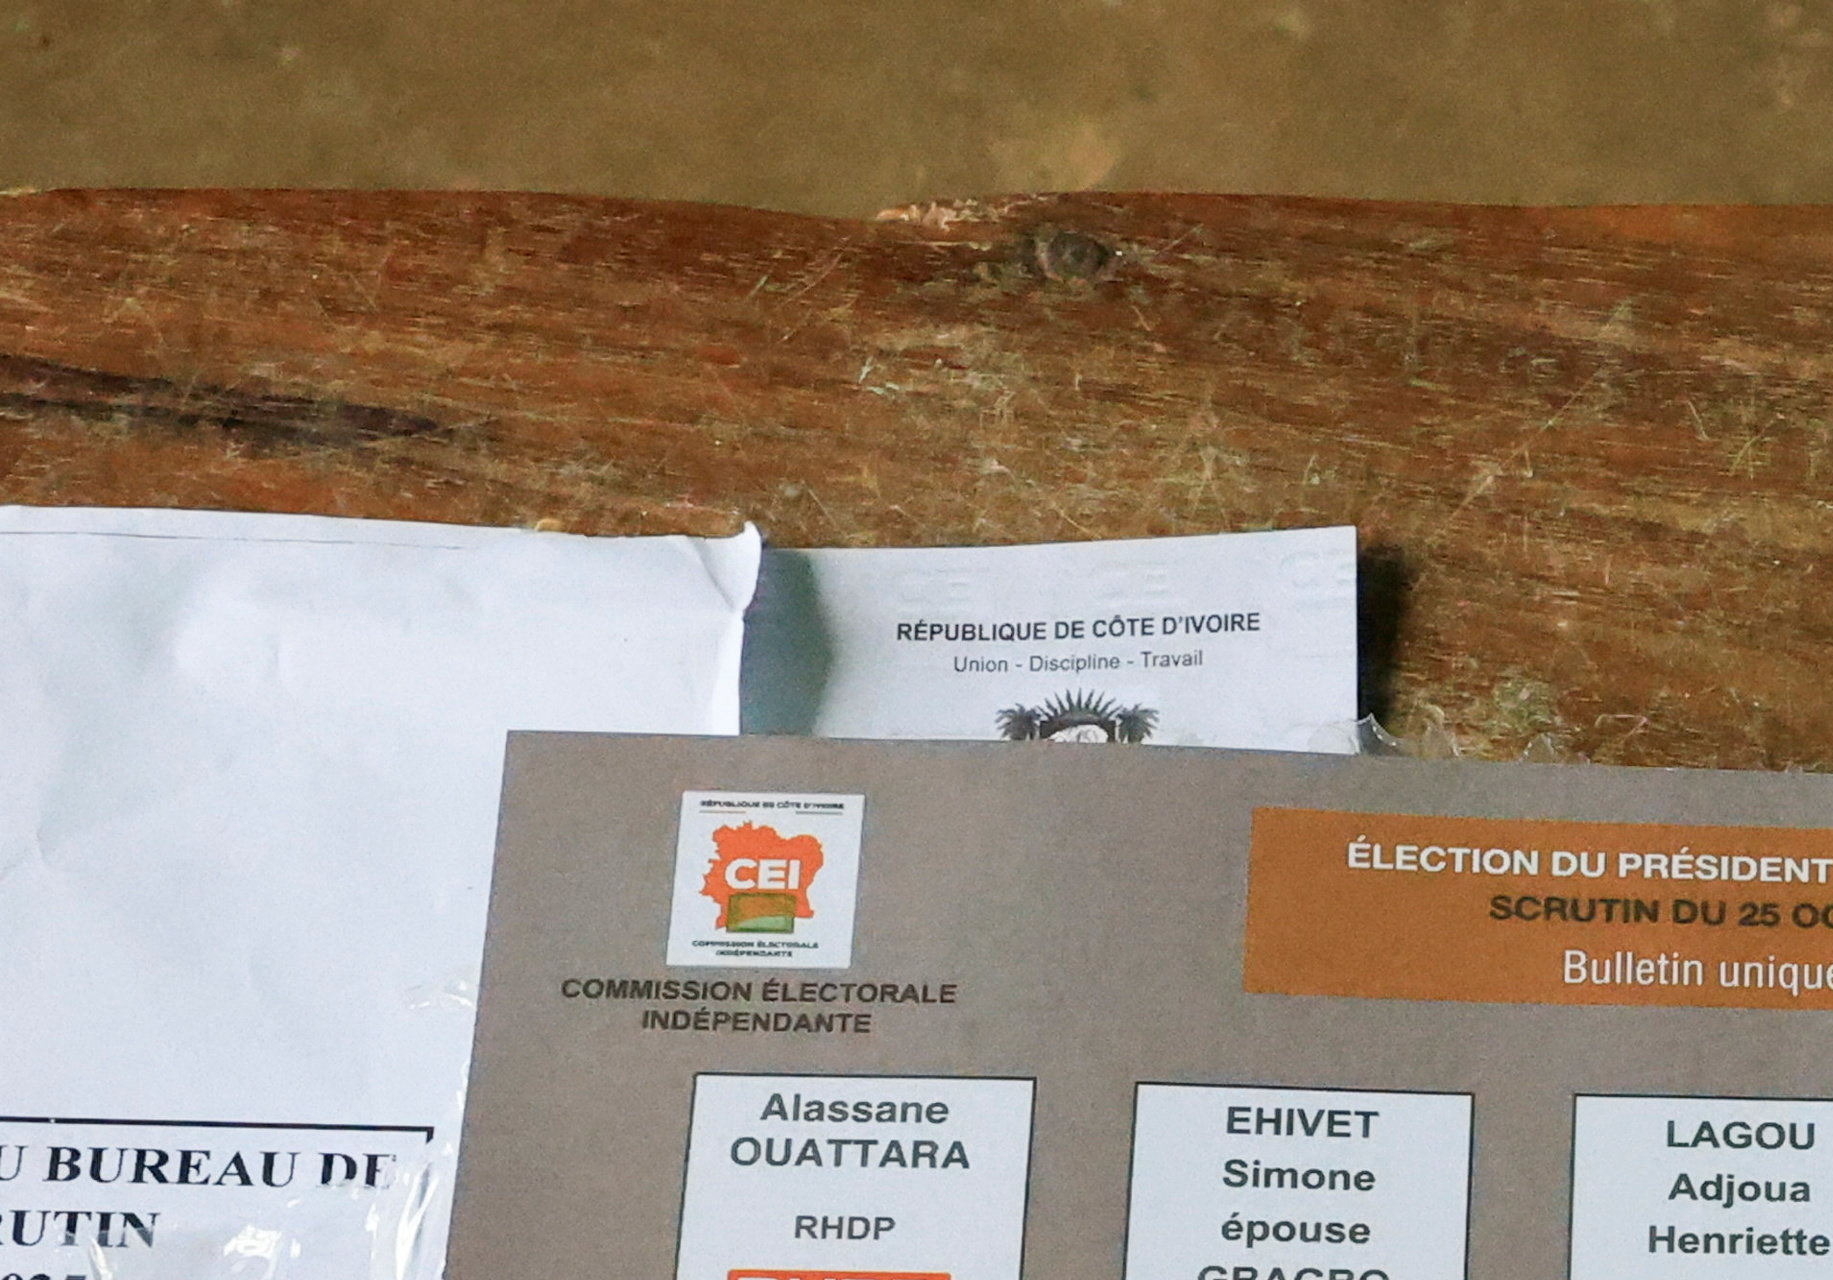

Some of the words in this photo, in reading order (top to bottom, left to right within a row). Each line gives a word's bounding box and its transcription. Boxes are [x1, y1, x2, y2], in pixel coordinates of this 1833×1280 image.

[897, 620, 1047, 643] RÉPUBLIQUE
[1054, 621, 1085, 640] DE
[1092, 614, 1154, 639] CÔTE
[1162, 612, 1260, 635] D'IVOIRE
[954, 655, 1008, 674] Union
[1029, 653, 1120, 675] Discipline
[1141, 649, 1203, 669] Travail
[724, 857, 801, 891] CEI
[1347, 835, 1539, 876] ÉLECTION
[1551, 851, 1606, 878] DU
[1618, 847, 1833, 884] PRÉSIDENT
[1489, 895, 1660, 924] SCRUTIN
[1672, 899, 1726, 926] DU
[1738, 902, 1781, 928] 25
[1563, 949, 1703, 988] Bulletin
[561, 979, 752, 1002] COMMISSION
[762, 977, 958, 1004] ÉLECTORALE
[641, 1006, 872, 1034] INDÉPENDANTE
[759, 1093, 950, 1124] Alassane
[1226, 1106, 1380, 1139] EHIVET
[1666, 1119, 1816, 1151] LAGOU
[42, 1146, 301, 1189] BUREAU
[317, 1152, 397, 1189] DE
[730, 1136, 970, 1170] OUATTARA
[1222, 1159, 1376, 1192] Simone
[1668, 1172, 1811, 1209] Adjoua
[0, 1210, 161, 1248] UTIN
[794, 1215, 896, 1241] RHDP
[1221, 1212, 1371, 1248] épouse
[1648, 1225, 1831, 1256] Henriette
